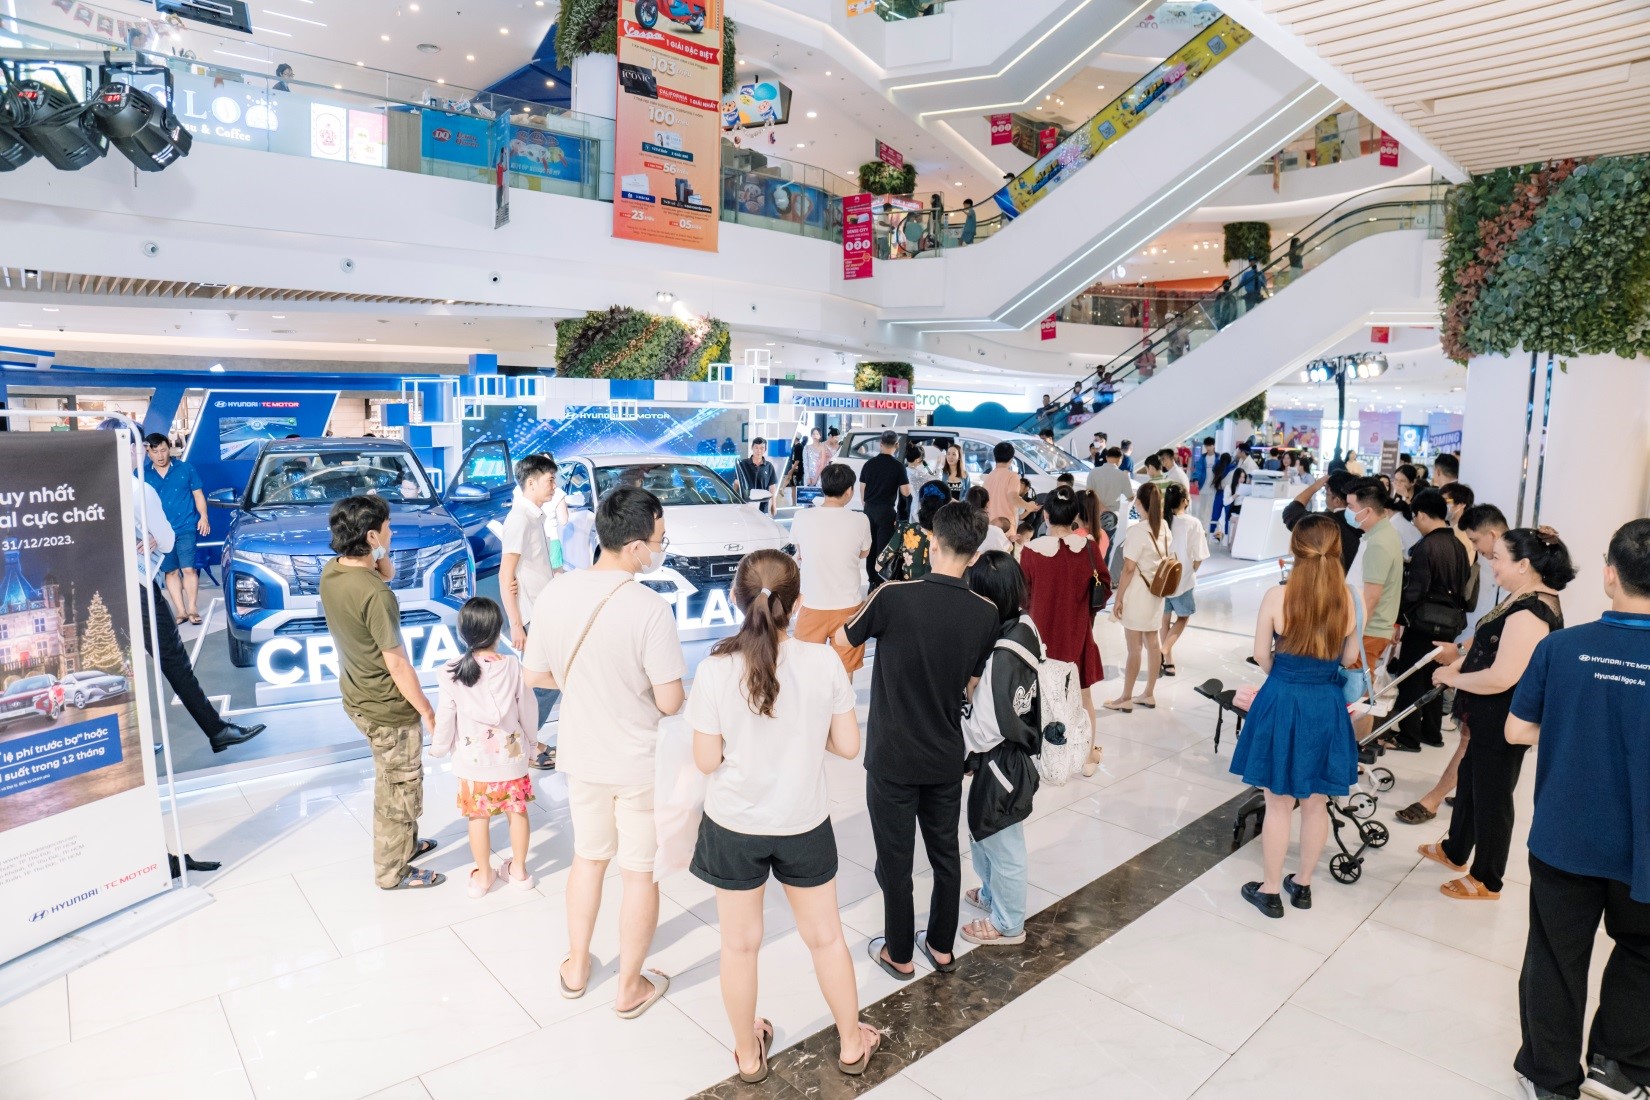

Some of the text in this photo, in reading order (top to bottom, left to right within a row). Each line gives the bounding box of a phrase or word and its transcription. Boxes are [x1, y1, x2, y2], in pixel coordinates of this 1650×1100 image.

[623, 20, 665, 40] Vespa
[651, 55, 676, 76] 103
[648, 105, 676, 126] 100
[201, 124, 210, 134] &
[216, 126, 251, 141] Coffee
[434, 130, 451, 141] DQ
[663, 163, 676, 175] 56
[631, 210, 644, 220] 23
[680, 218, 692, 230] 05
[809, 397, 914, 410] HYUNDAI TC MOTOR
[916, 393, 950, 406] crocs
[0, 484, 75, 508] uy nhất
[0, 504, 105, 528] al cực chất
[2, 535, 75, 551] 31/12/2023.
[257, 624, 462, 685] CRTA
[1591, 656, 1622, 666] HYUNDAI
[1594, 672, 1621, 682] Hyundai
[3, 752, 14, 762] lệ
[16, 746, 32, 760] phí
[34, 740, 62, 754] trước
[84, 728, 108, 740] hoặc
[4, 746, 105, 782] suất trong 12 tháng
[51, 863, 158, 913] HYUNDAI TC MOTOR
